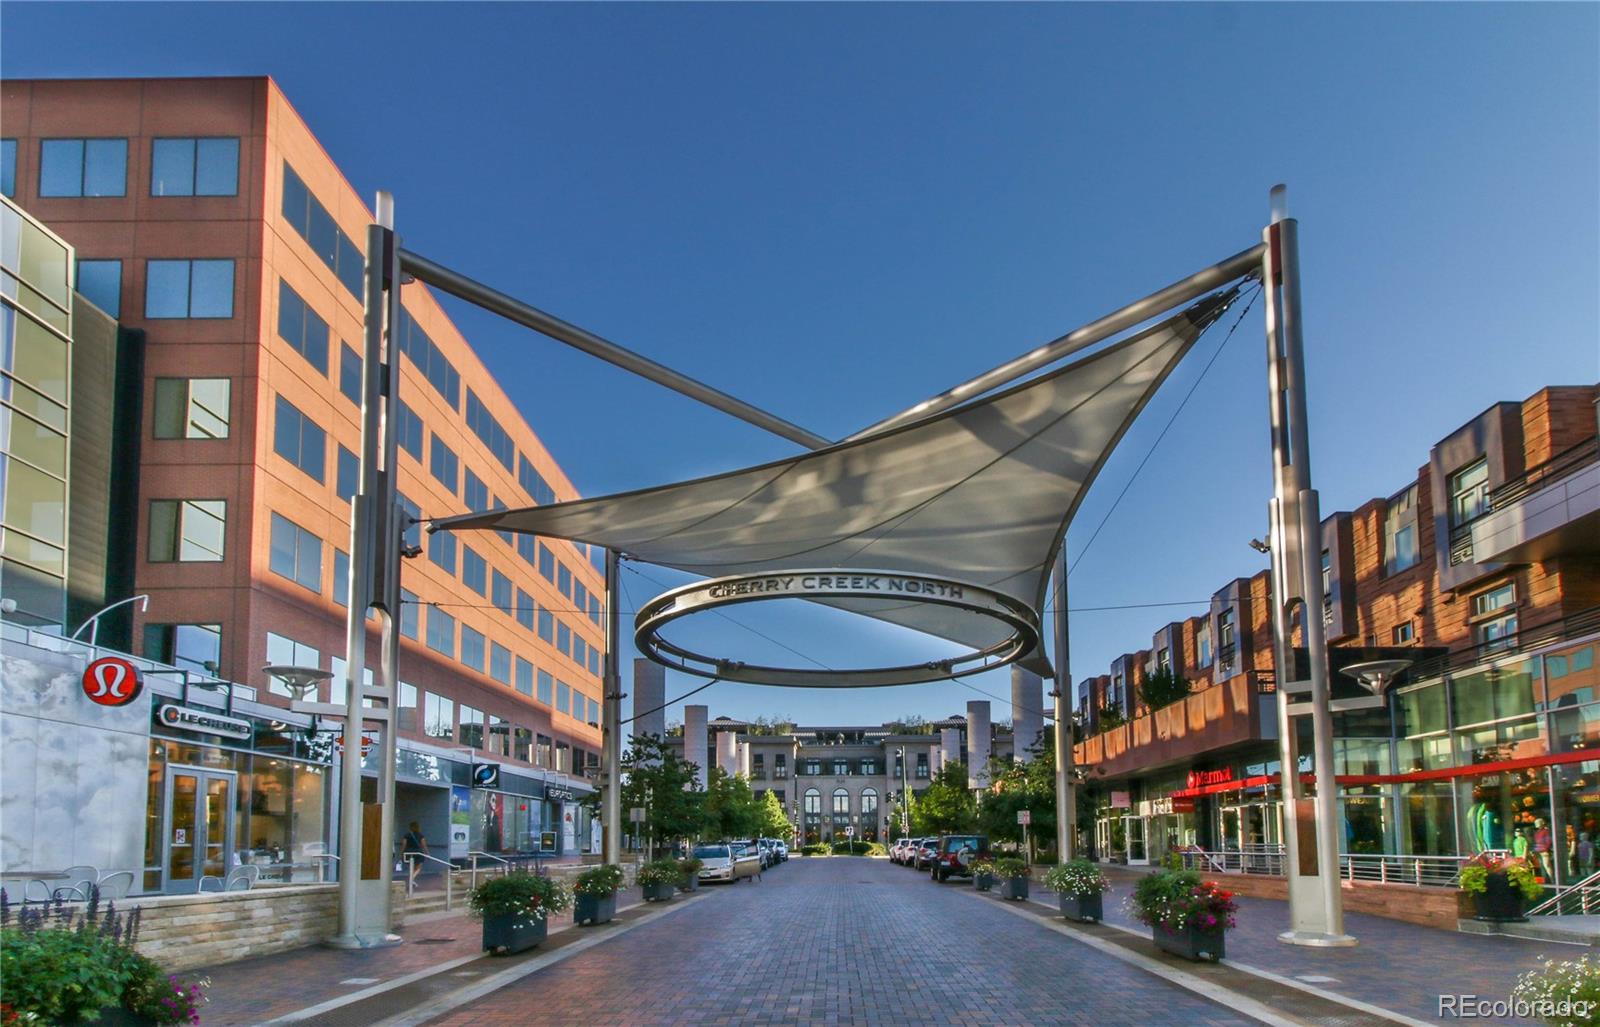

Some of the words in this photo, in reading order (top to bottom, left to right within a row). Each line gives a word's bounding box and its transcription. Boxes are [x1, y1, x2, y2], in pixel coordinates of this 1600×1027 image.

[709, 578, 794, 598] CHERRY
[802, 576, 880, 590] CREEK
[888, 578, 963, 599] NORTH
[1195, 768, 1232, 786] Marmot
